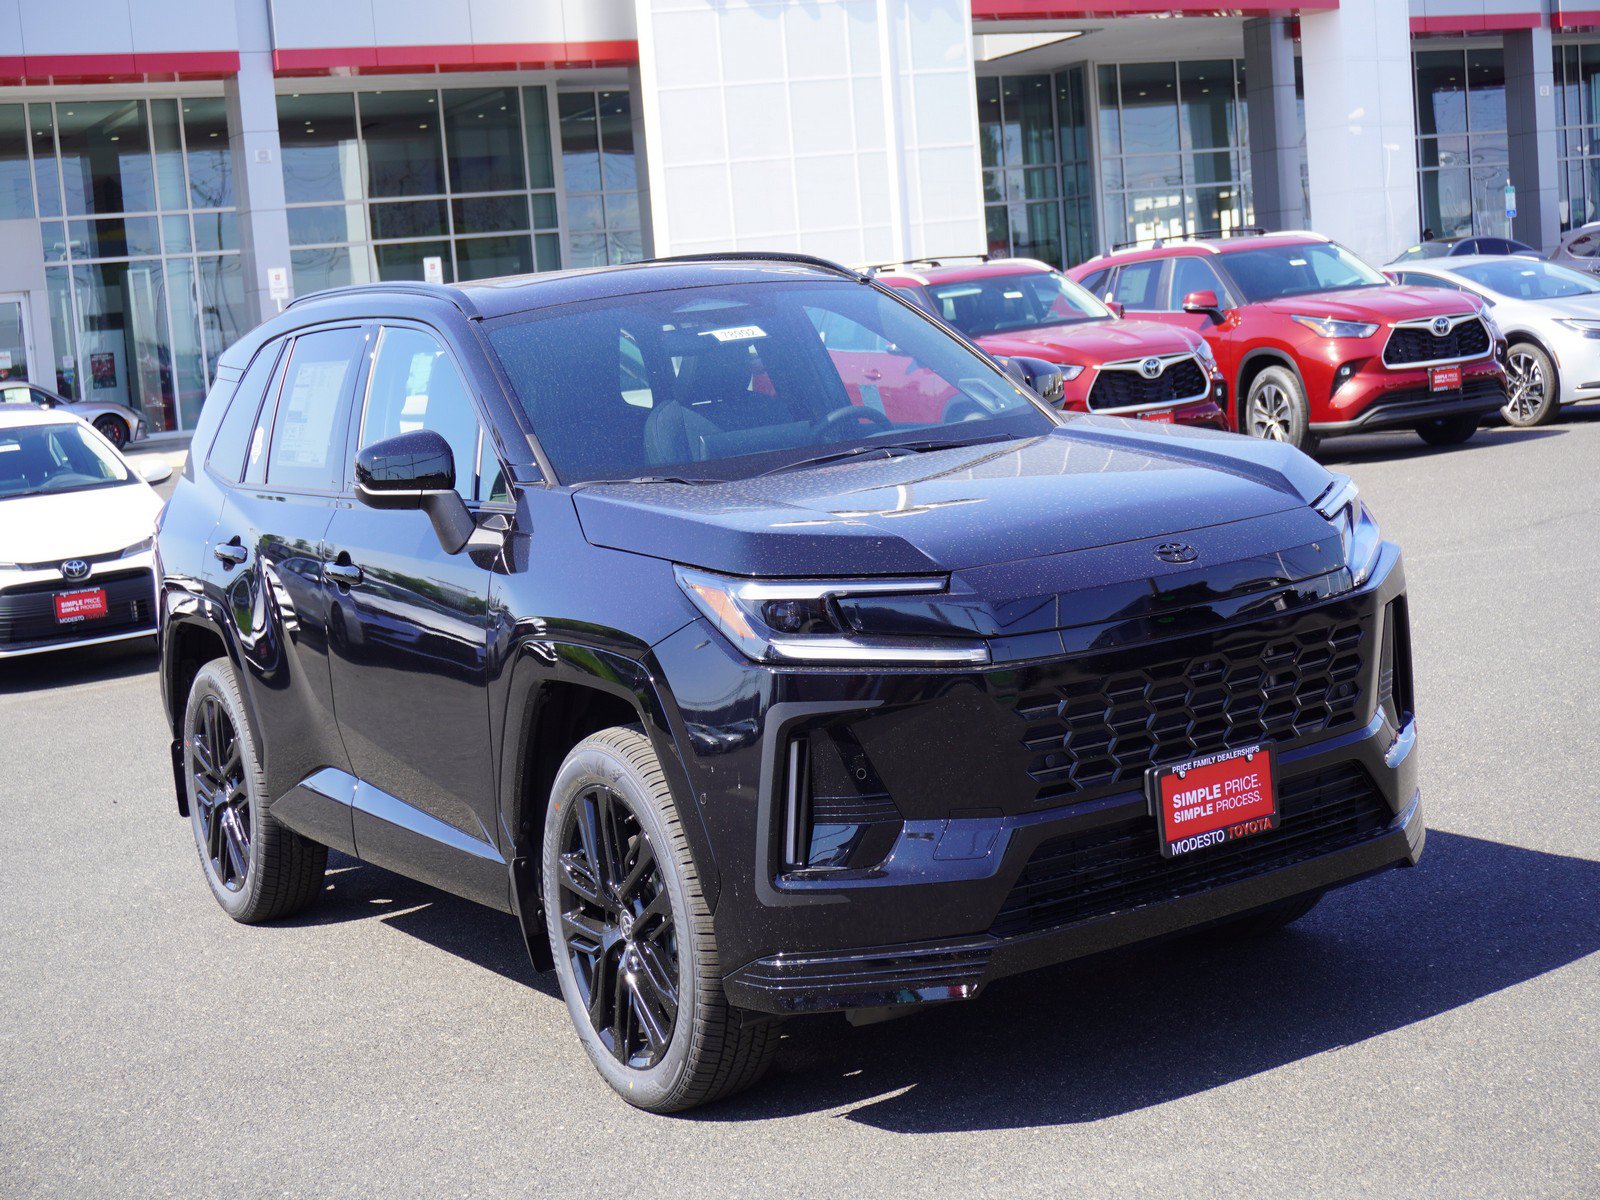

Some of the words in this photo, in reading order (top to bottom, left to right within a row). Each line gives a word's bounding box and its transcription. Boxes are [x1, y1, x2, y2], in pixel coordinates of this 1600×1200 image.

[61, 600, 83, 608] SIMPLE
[1172, 763, 1192, 774] PRICE
[1193, 756, 1216, 769] FAMILY
[1217, 745, 1260, 763] DEALERSHIPS
[1172, 783, 1222, 809] SIMPLE
[1224, 773, 1262, 795] PRICE.
[1173, 803, 1214, 823] SIMPLE
[1216, 790, 1263, 813] PROCESS.
[1171, 829, 1225, 856] MODESTO
[1227, 817, 1273, 839] TOYOTA
